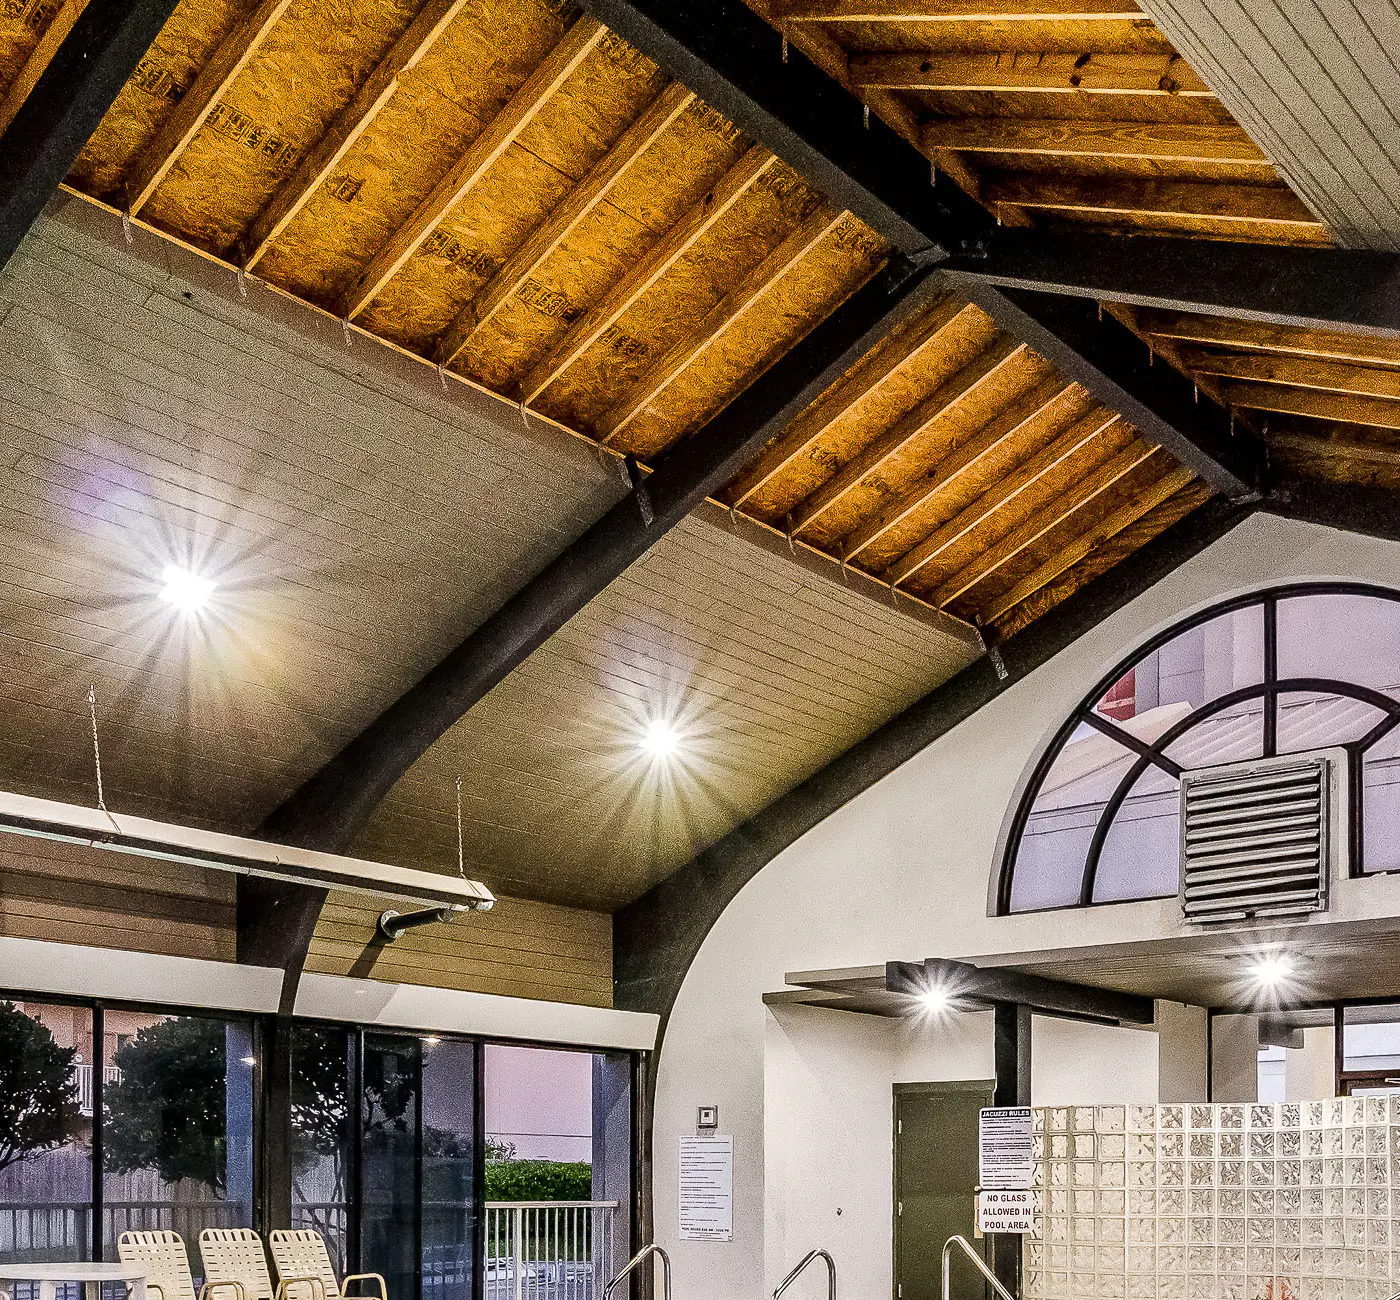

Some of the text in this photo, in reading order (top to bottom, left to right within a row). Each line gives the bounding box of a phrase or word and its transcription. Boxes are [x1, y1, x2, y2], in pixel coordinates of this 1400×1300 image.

[987, 1194, 1027, 1203] NO GLASS
[982, 1207, 1031, 1216] ALLOWED IN
[984, 1221, 1030, 1229] POOL AREA
